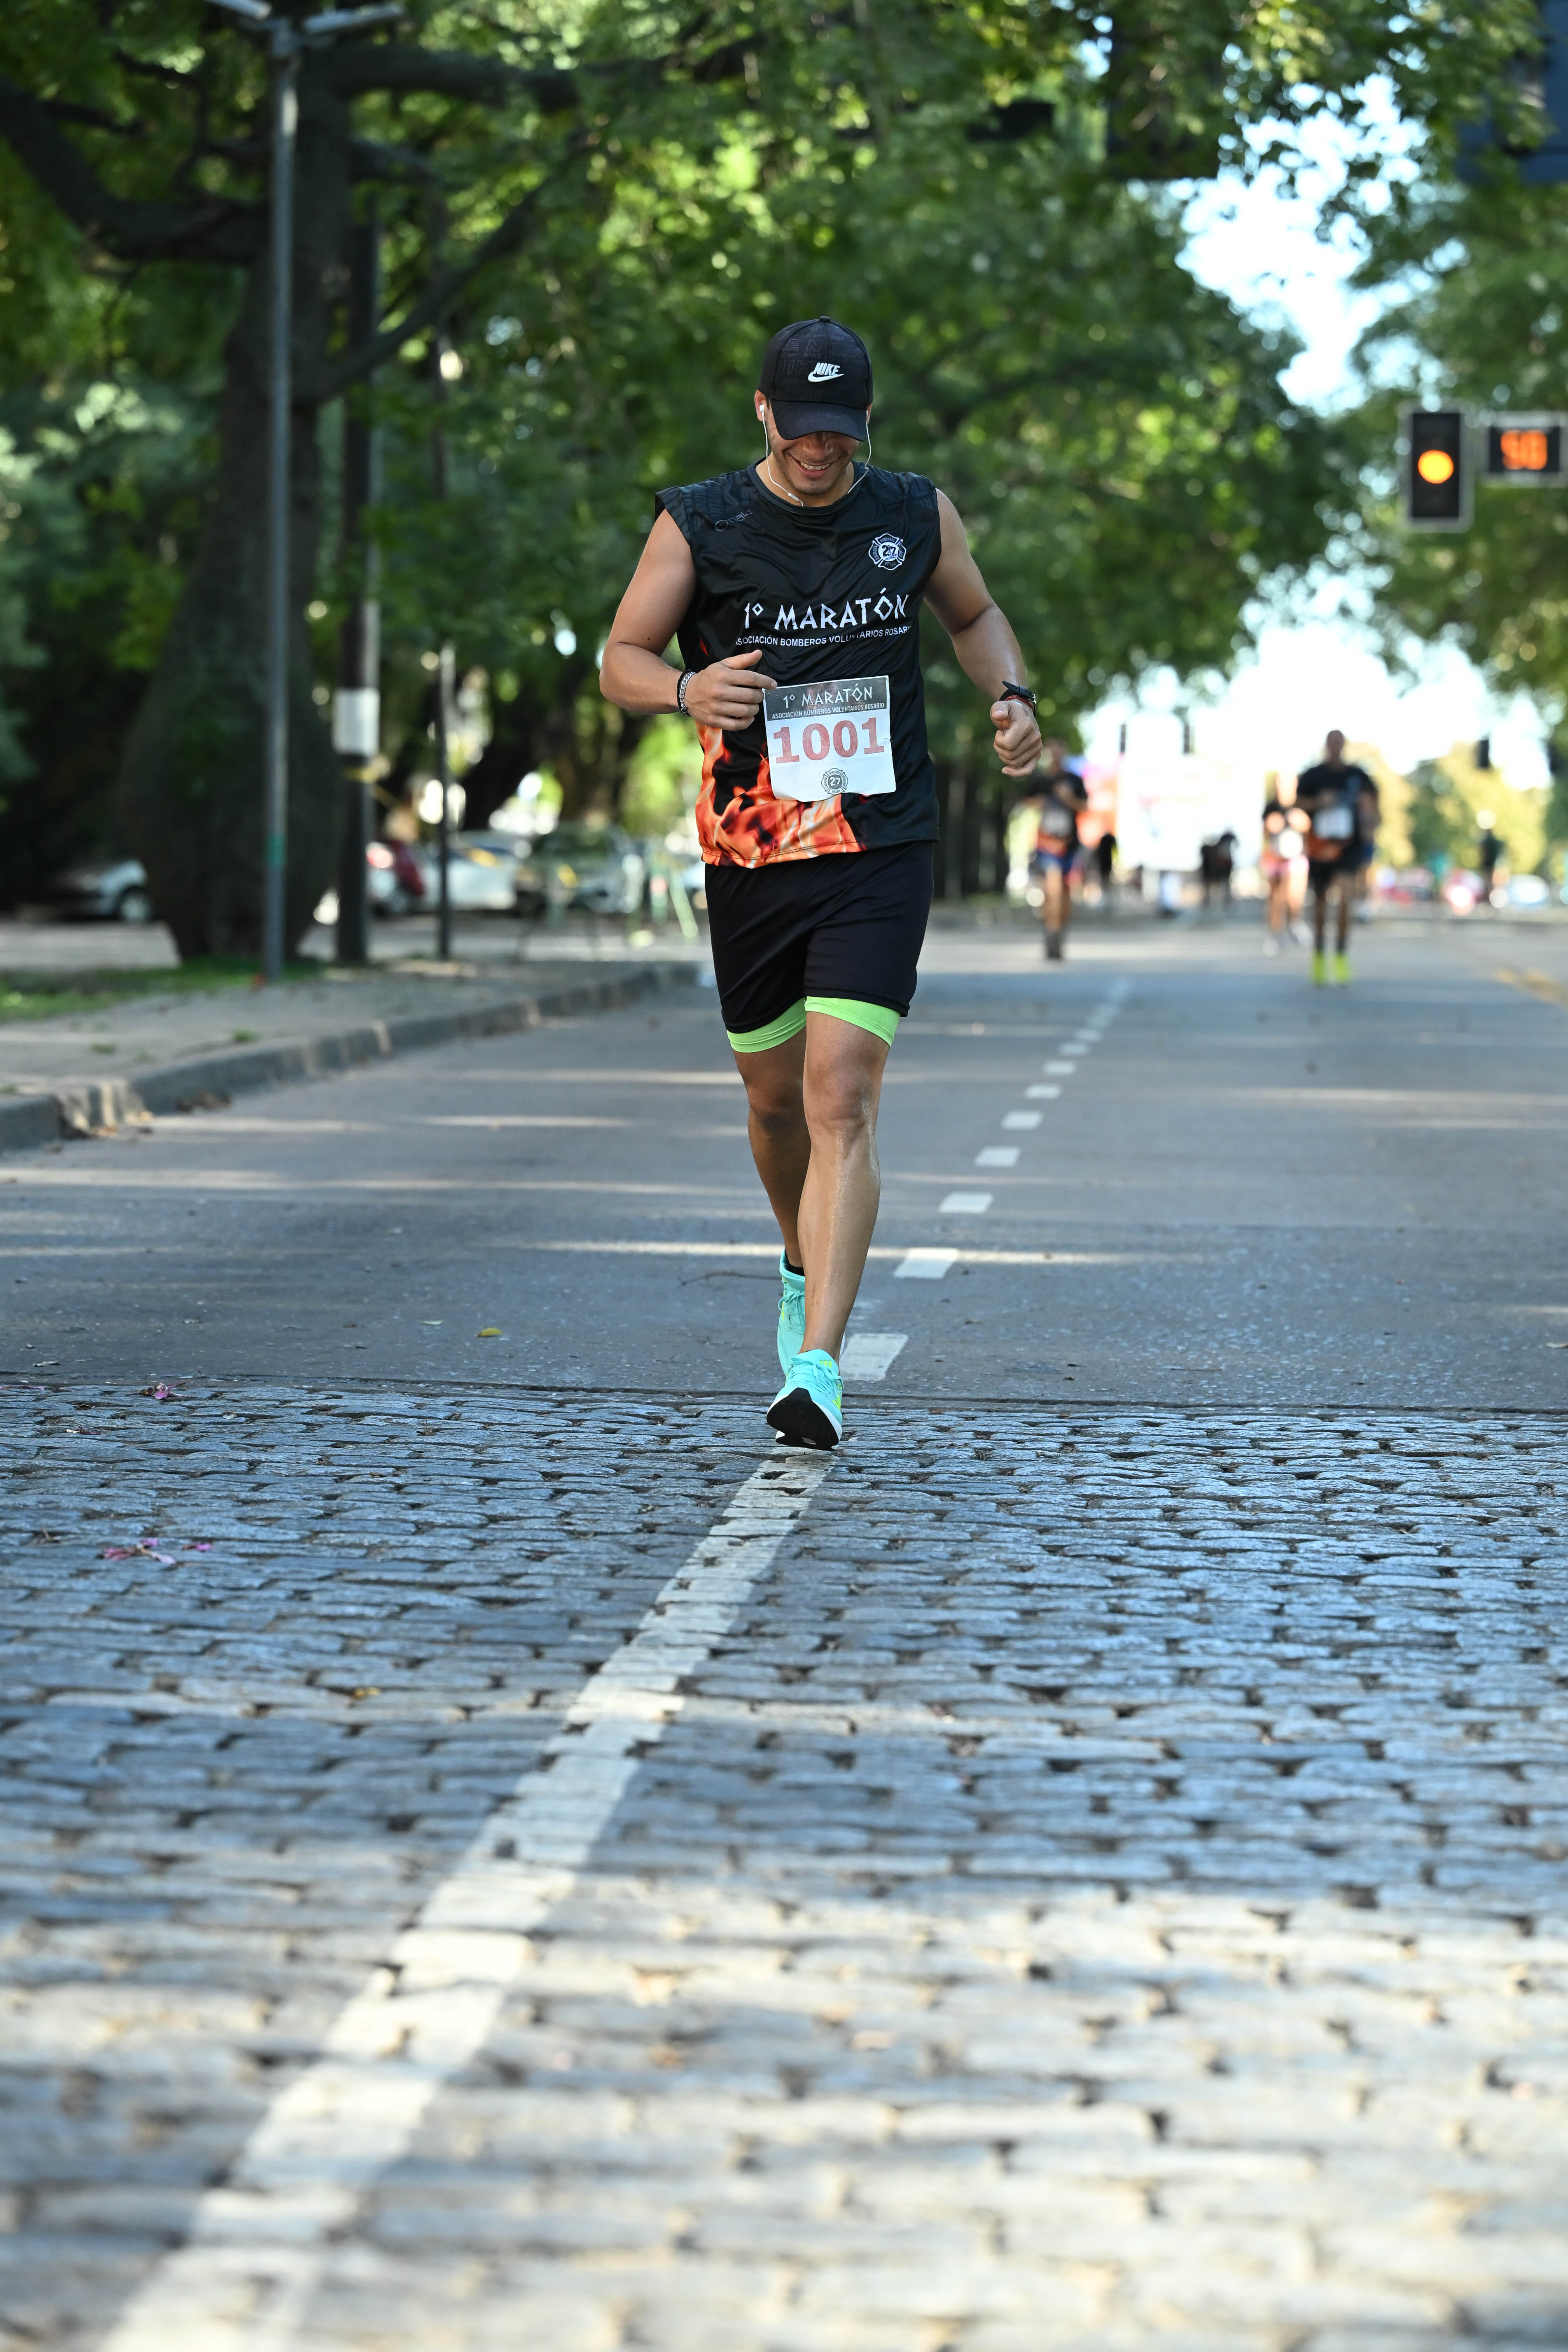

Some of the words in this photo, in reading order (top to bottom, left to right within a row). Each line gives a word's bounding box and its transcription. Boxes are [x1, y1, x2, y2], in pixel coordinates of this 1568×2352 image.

[813, 362, 840, 376] NIKE
[882, 544, 896, 557] 27
[774, 587, 909, 630] MARATÓN
[780, 637, 827, 646] BOMBEROS
[802, 683, 873, 707] MARATÓN
[772, 709, 802, 719] ASOCIACIÓN
[832, 704, 864, 713] VOLUNTARIOS
[773, 717, 884, 764] 1001
[830, 777, 840, 786] 27
